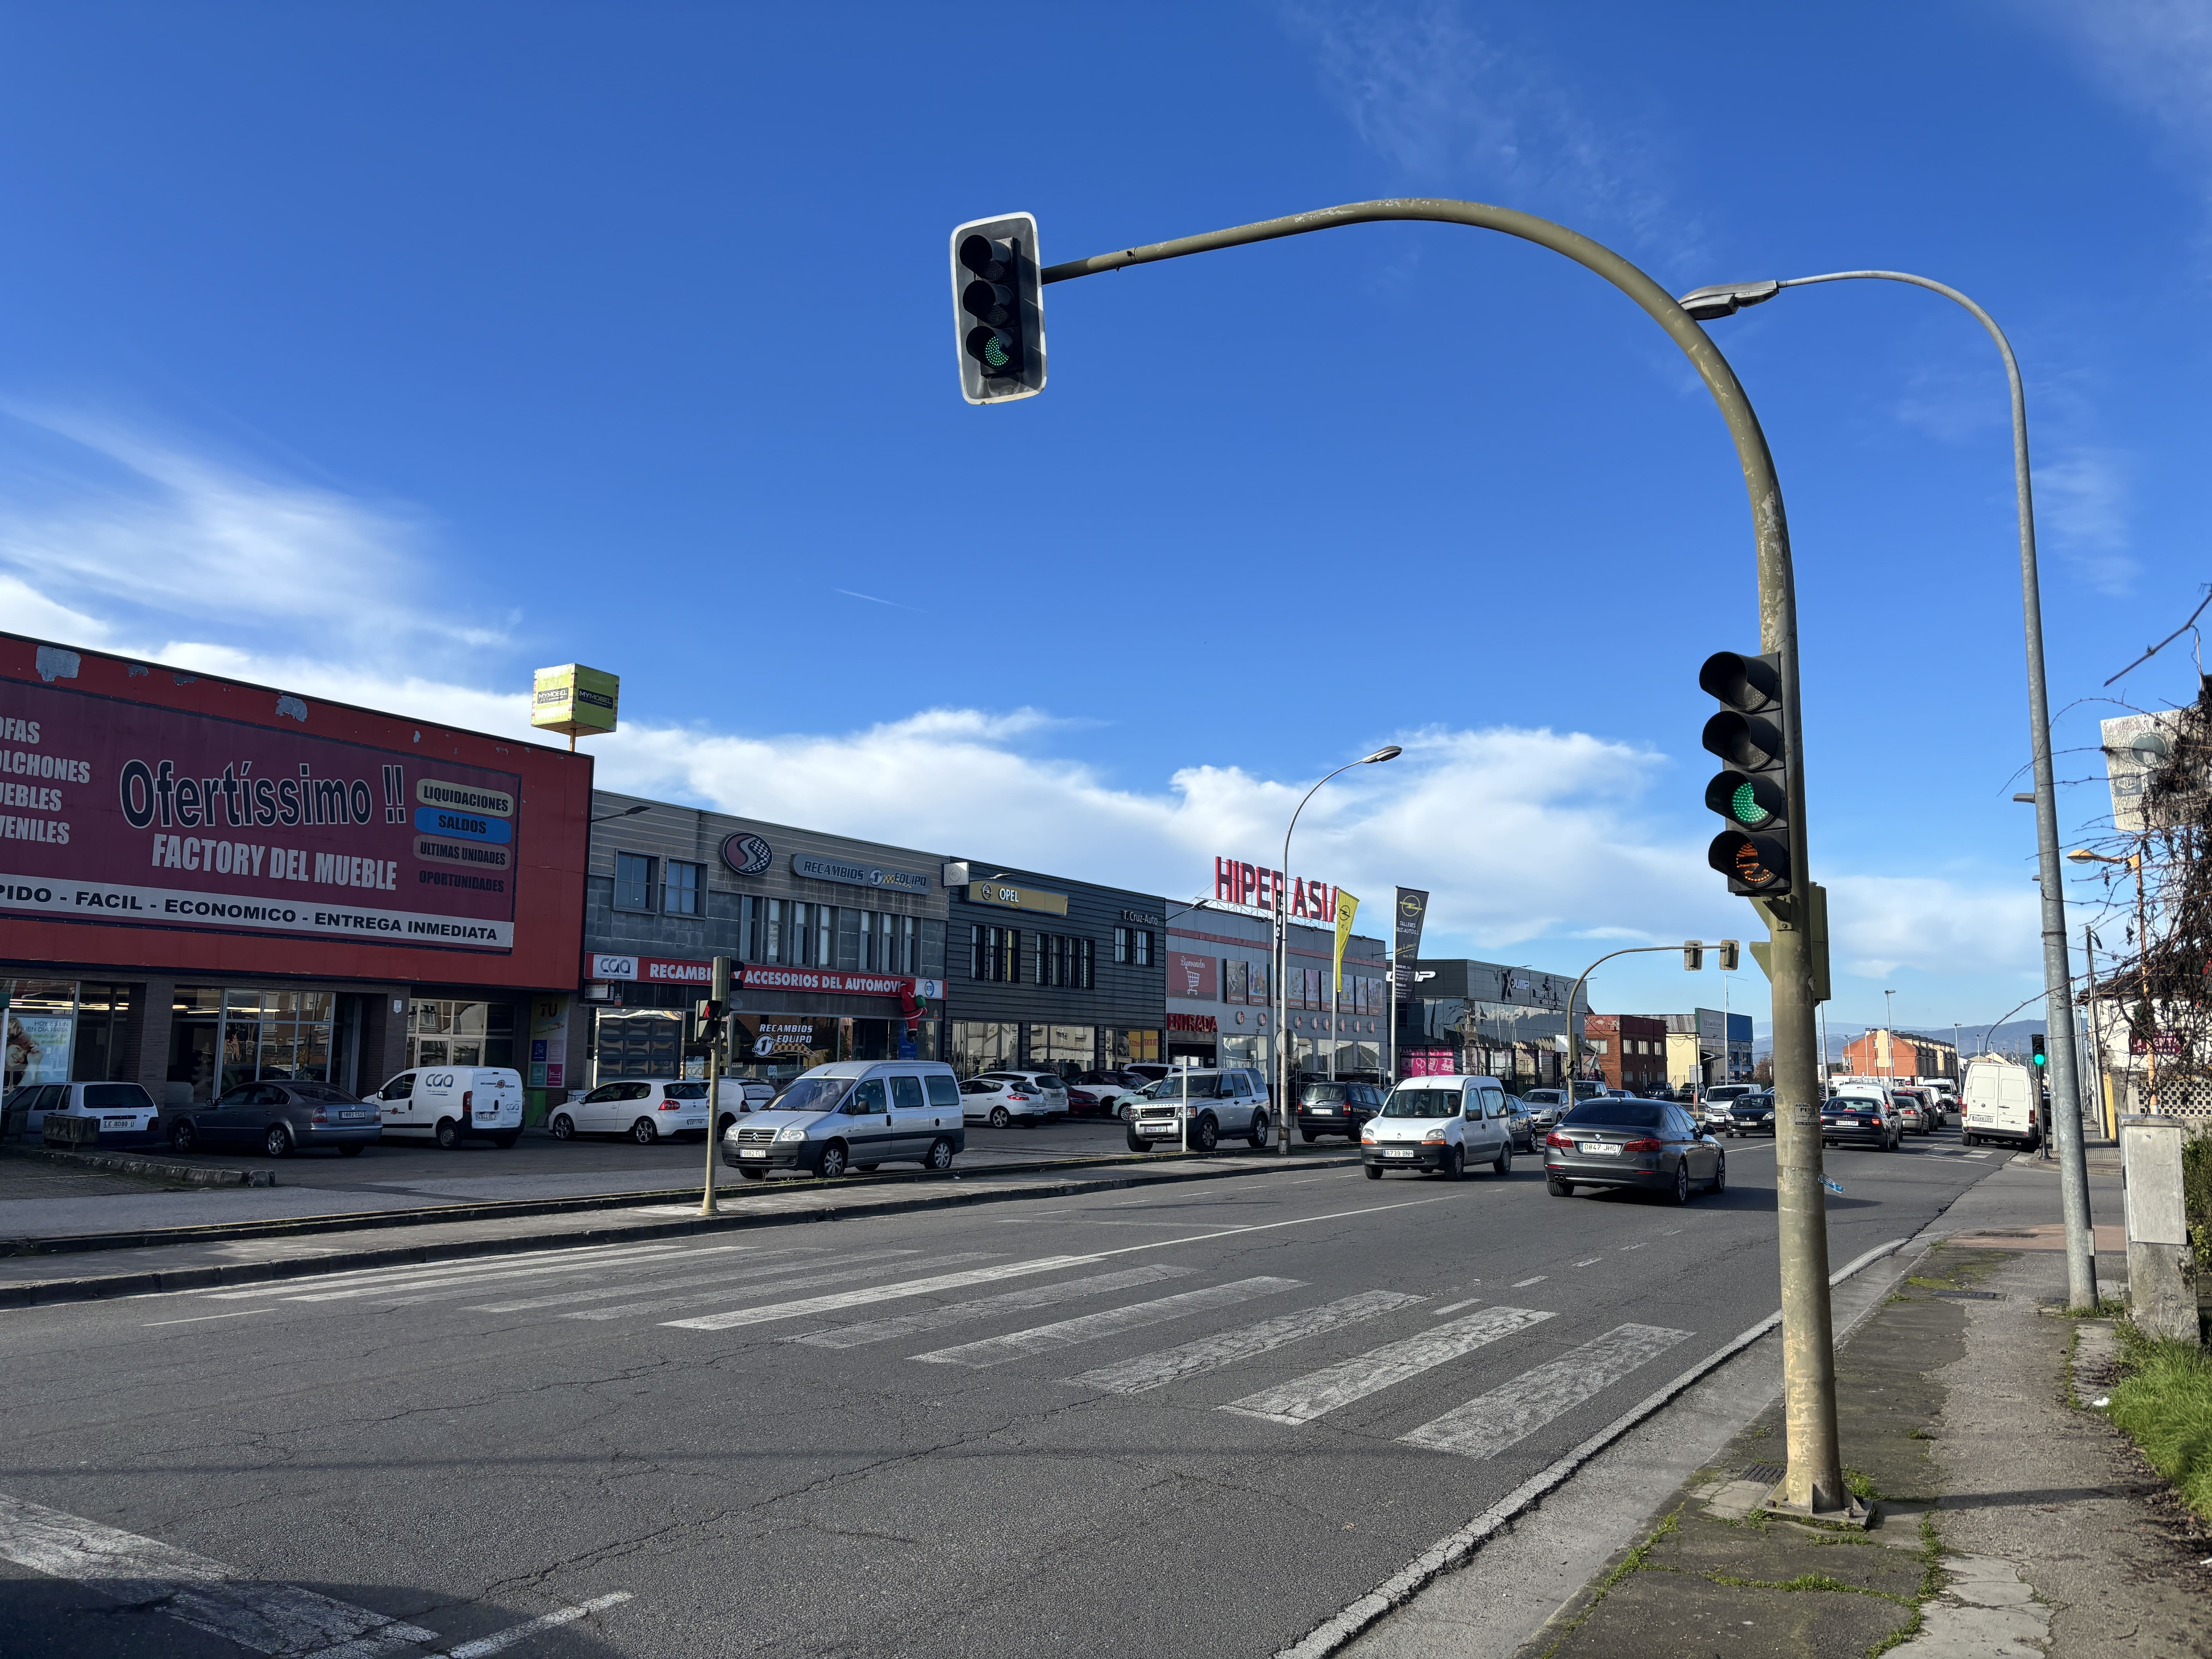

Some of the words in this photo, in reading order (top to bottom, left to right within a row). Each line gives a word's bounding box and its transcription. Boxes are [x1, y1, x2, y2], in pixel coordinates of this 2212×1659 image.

[579, 690, 612, 704] MYMOBEL
[0, 750, 90, 783] LCHONES
[120, 759, 373, 829] Ofertíssimo
[423, 785, 508, 812] LIQUIDACIONES
[438, 814, 486, 834] SALDOS
[151, 833, 265, 877] FACTORY
[269, 847, 309, 882] DEL
[314, 852, 397, 891] MUEBLE
[420, 842, 460, 860] ULTIMAS
[461, 847, 506, 866] UNIDADES
[419, 870, 504, 893] OPORTUNIDADES
[803, 860, 864, 880] RECAMBIOS
[894, 872, 927, 887] EQUIPO
[1000, 888, 1019, 902] OPEL
[76, 891, 143, 910] FACIL
[164, 899, 296, 923] ECONOMICO
[314, 912, 402, 932] ENTREGA
[408, 921, 498, 940] INMEDIATA
[1123, 910, 1129, 920] T.
[1130, 911, 1158, 925] Cruz-Auto
[1180, 955, 1206, 969] Bienvenidos
[650, 963, 714, 981] RECAMBI
[744, 970, 819, 988] ACCESORIOS
[822, 975, 842, 989] DEL
[759, 1024, 813, 1033] RECAMBIOS
[1167, 1013, 1218, 1032] ENTRADA
[777, 1035, 812, 1043] EQUIPO
